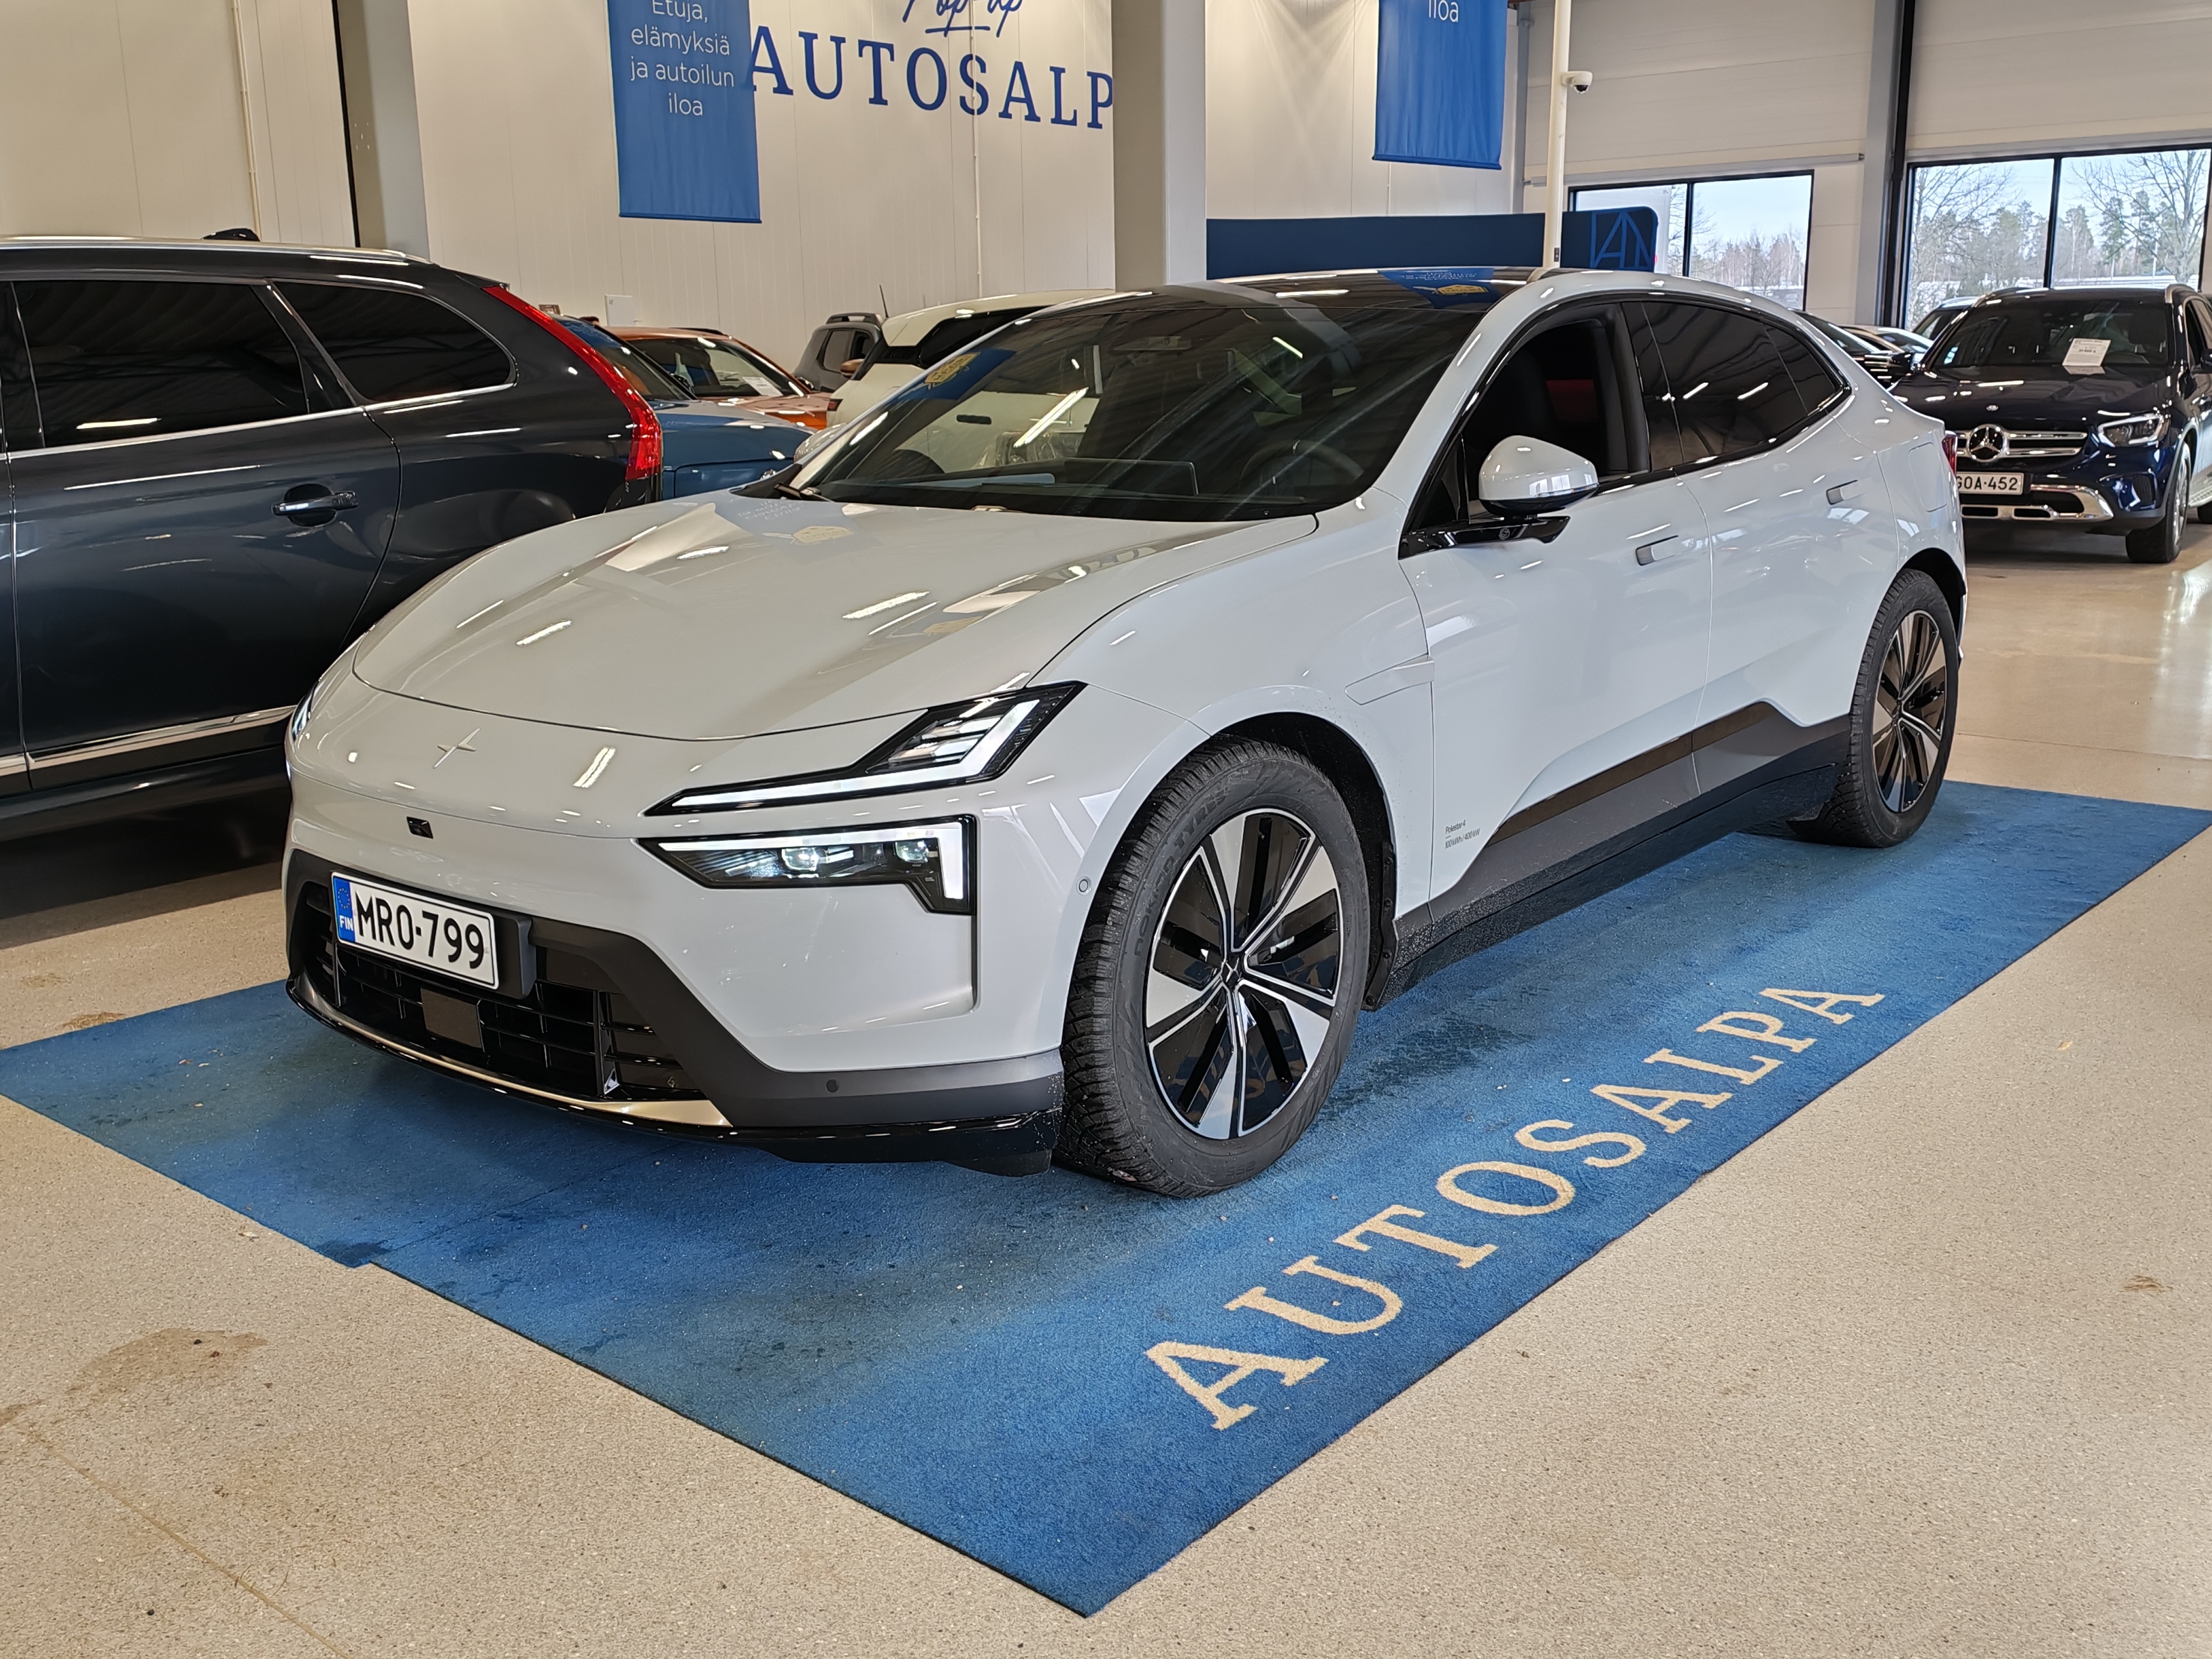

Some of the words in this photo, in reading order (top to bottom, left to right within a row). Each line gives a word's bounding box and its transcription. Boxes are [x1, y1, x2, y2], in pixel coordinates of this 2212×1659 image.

[652, 0, 707, 23] Etuja,
[631, 23, 730, 56] elämyksiä
[630, 56, 648, 81] ja
[655, 62, 734, 87] autoilun
[669, 92, 703, 116] iloa
[1445, 822, 1462, 835] Polestar
[339, 915, 354, 932] FIN
[355, 891, 485, 969] MRO-799
[1146, 987, 1885, 1431] AUTOSALPA
